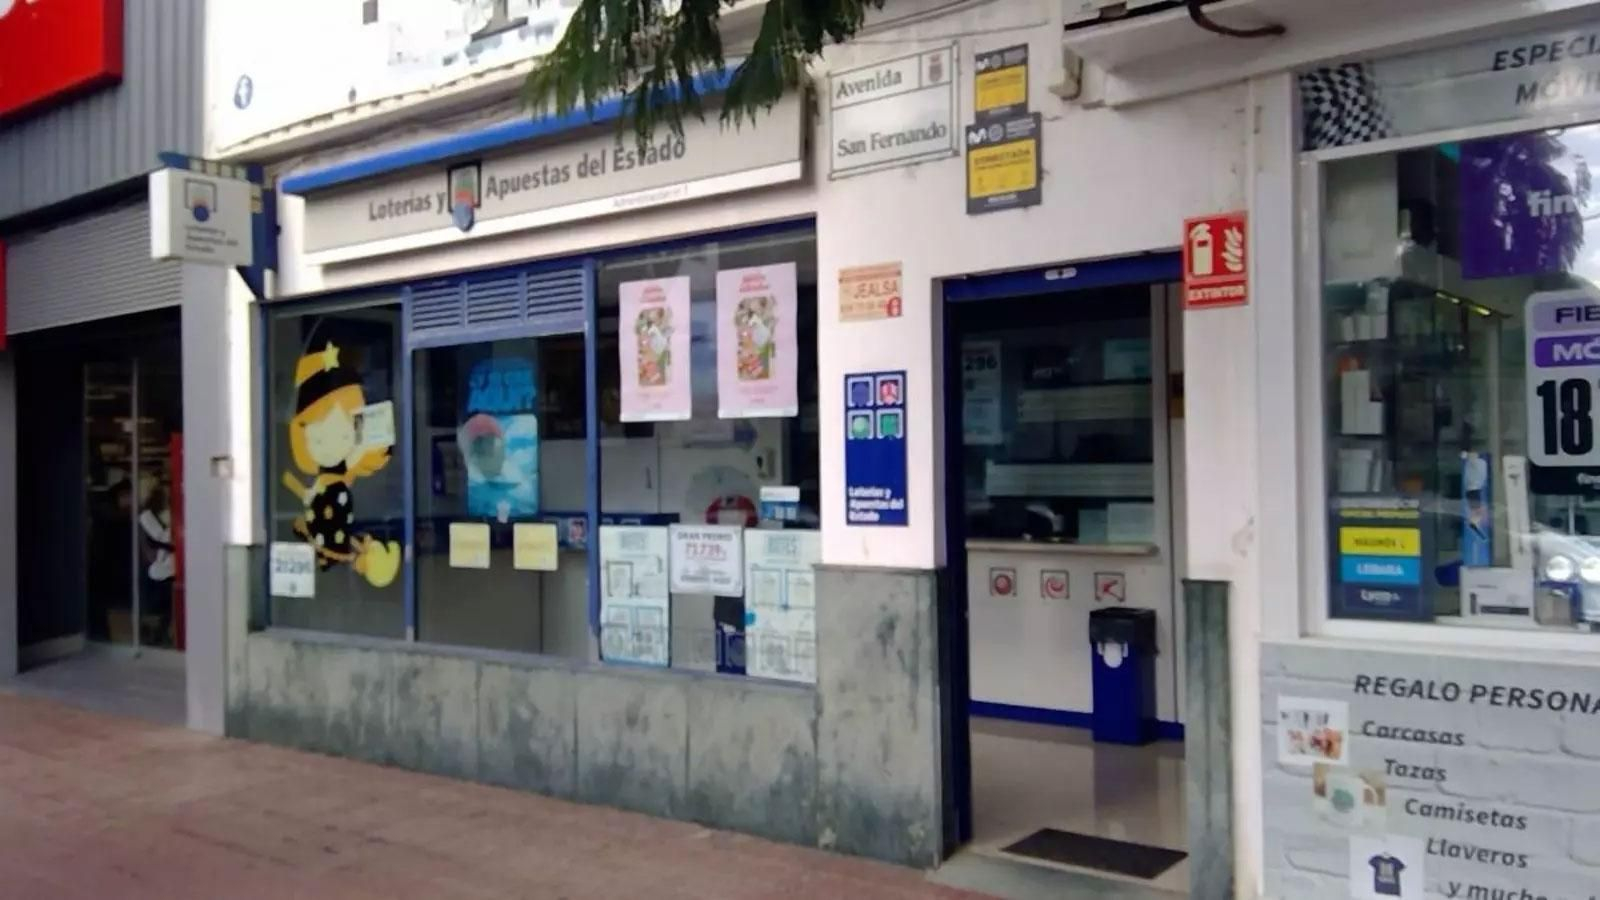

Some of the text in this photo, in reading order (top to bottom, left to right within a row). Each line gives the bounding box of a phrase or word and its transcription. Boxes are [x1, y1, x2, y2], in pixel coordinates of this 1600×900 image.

[836, 70, 903, 99] Avenida
[837, 121, 947, 157] San Fernando
[436, 191, 447, 215] y
[486, 163, 571, 200] Apuestas
[577, 149, 606, 179] del
[1188, 284, 1245, 301] EXTINTOR
[1353, 674, 1461, 702] REGALO
[1361, 720, 1466, 747] Carcasas
[1384, 758, 1448, 782] Tazas
[1404, 798, 1528, 831] Camisetas
[1426, 837, 1529, 869] Llaveros
[1447, 881, 1548, 900] y much
